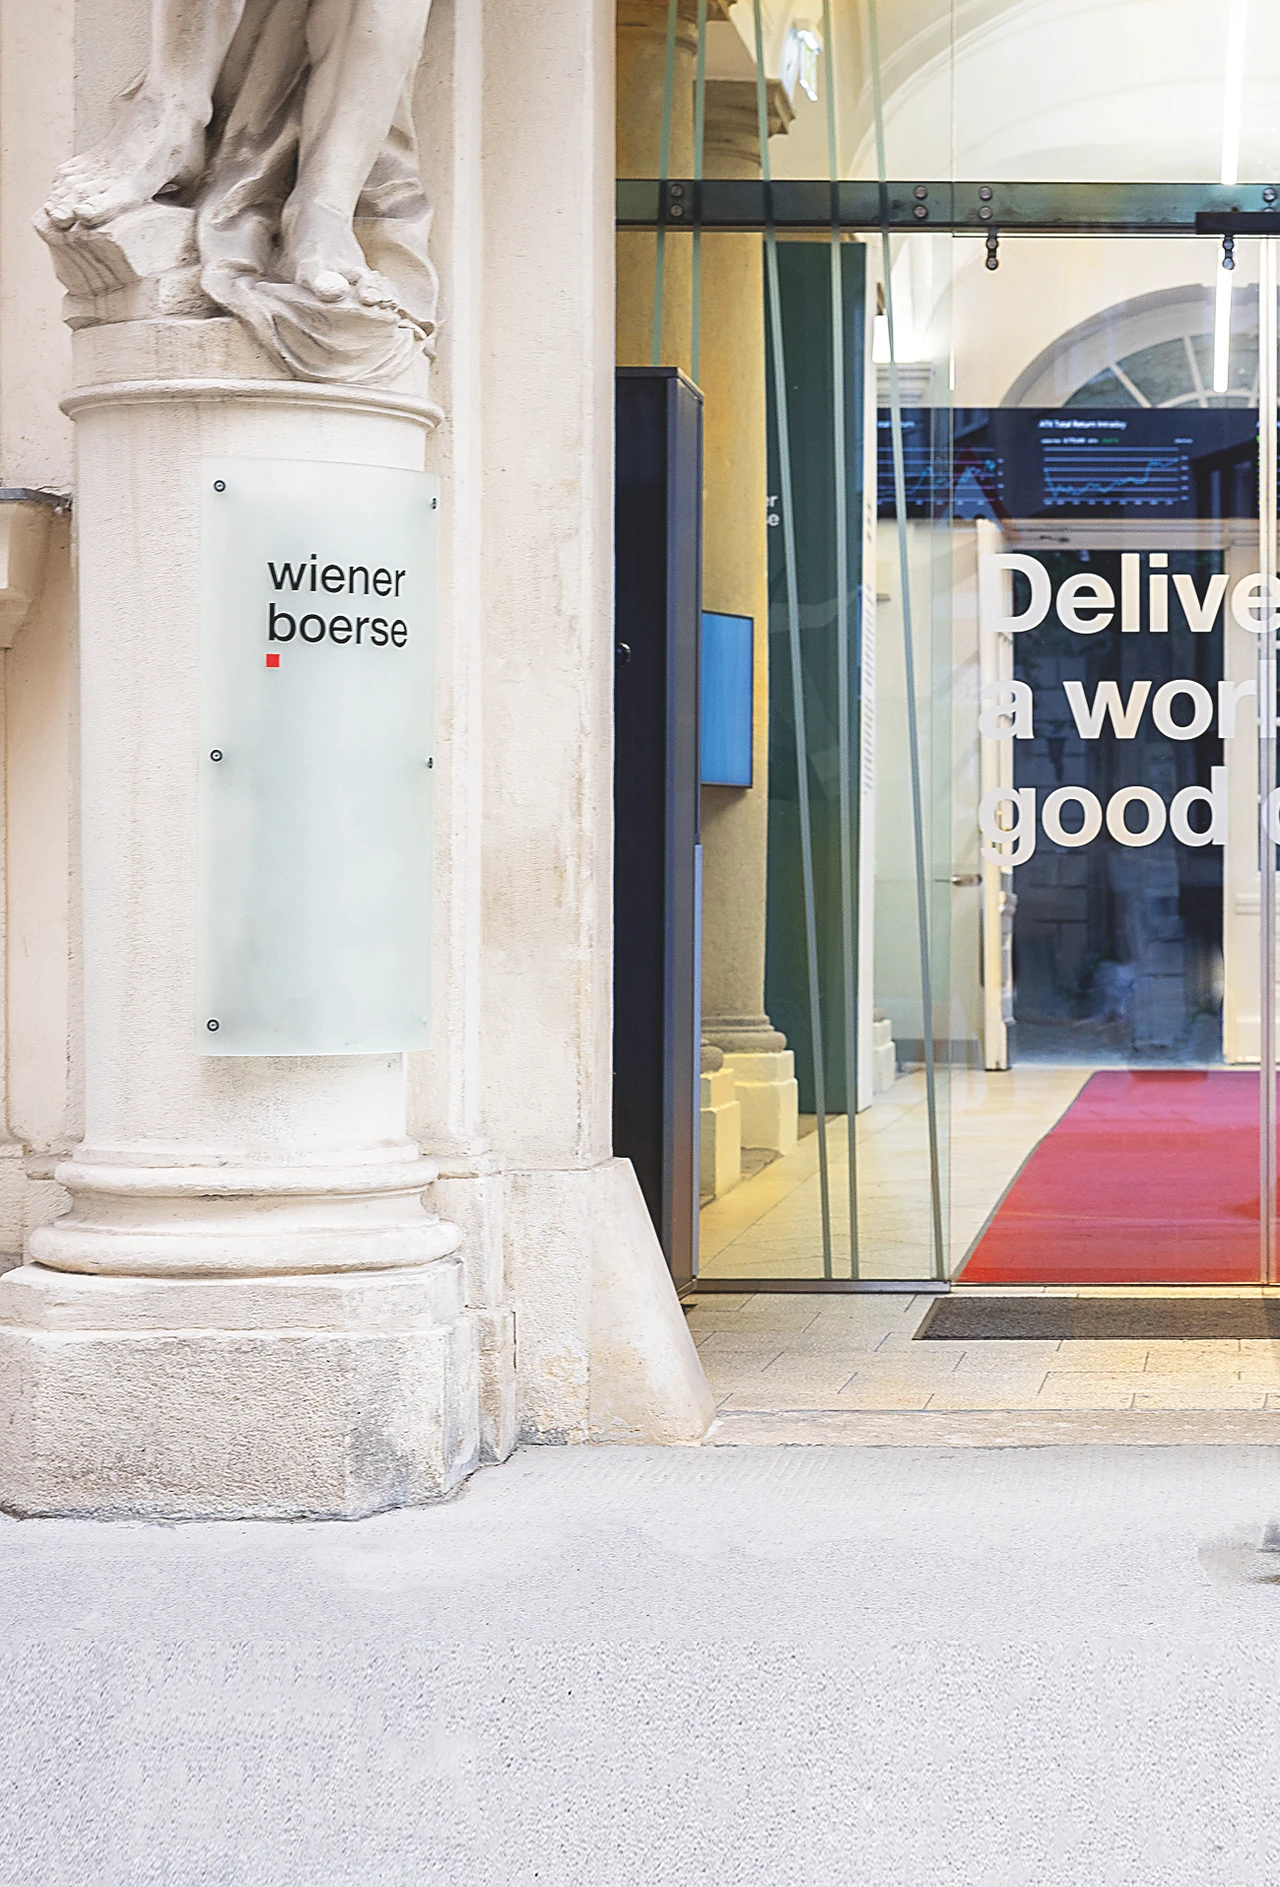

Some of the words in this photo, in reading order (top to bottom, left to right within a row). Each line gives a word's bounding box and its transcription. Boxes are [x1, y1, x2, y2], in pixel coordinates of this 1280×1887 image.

[267, 553, 406, 597] wiener
[268, 602, 408, 648] boerse
[978, 679, 1035, 740] a
[978, 765, 1229, 867] good
